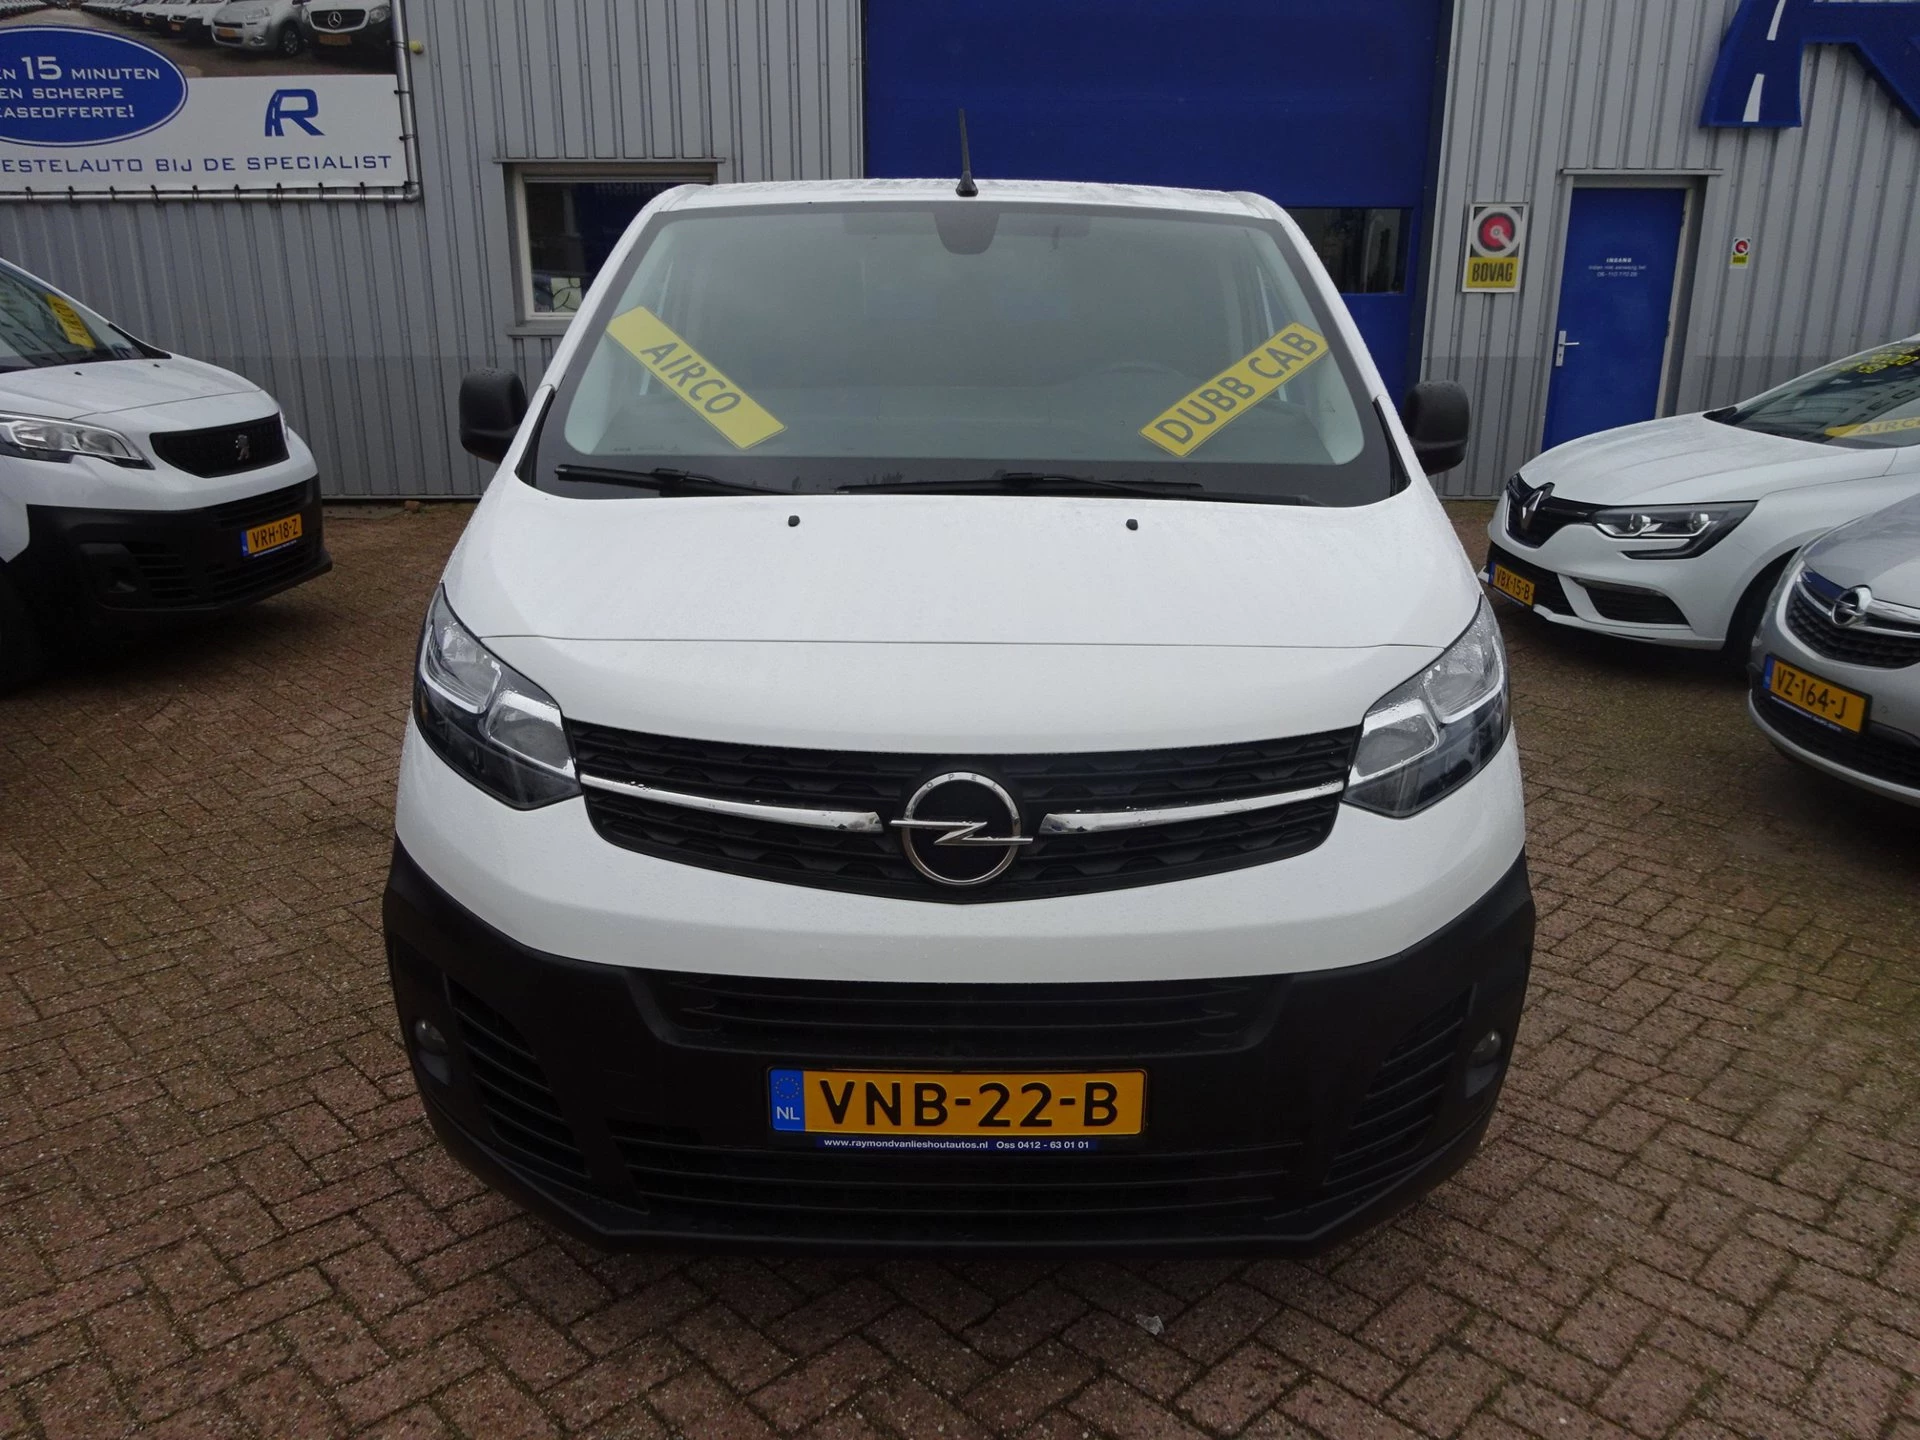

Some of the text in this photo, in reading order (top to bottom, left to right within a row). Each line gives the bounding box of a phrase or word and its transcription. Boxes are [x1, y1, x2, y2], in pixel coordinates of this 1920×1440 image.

[21, 56, 62, 80] 15
[71, 68, 161, 80] MINUTEN
[33, 87, 124, 99] SCHERPE
[0, 105, 135, 118] ASEOFFERTE!
[156, 159, 192, 172] BIJ
[204, 158, 236, 171] DE
[247, 155, 392, 170] SPECIALIST
[1472, 262, 1514, 282] BOVAG
[640, 342, 741, 414] AIRCO
[1154, 332, 1318, 445] DUBB CAB
[252, 518, 298, 548] VRH-18-Z
[1777, 666, 1847, 719] VZ-164-J
[925, 773, 998, 792] OPEL
[776, 1080, 1118, 1127] NL VNB-22-B
[824, 1138, 988, 1150] www.raymondvanlieshoutautos.nl
[996, 1141, 1016, 1150] Oss
[1017, 1141, 1041, 1149] 0412
[1049, 1141, 1062, 1149] 63
[1064, 1141, 1076, 1149] 01
[1078, 1141, 1089, 1149] 01
